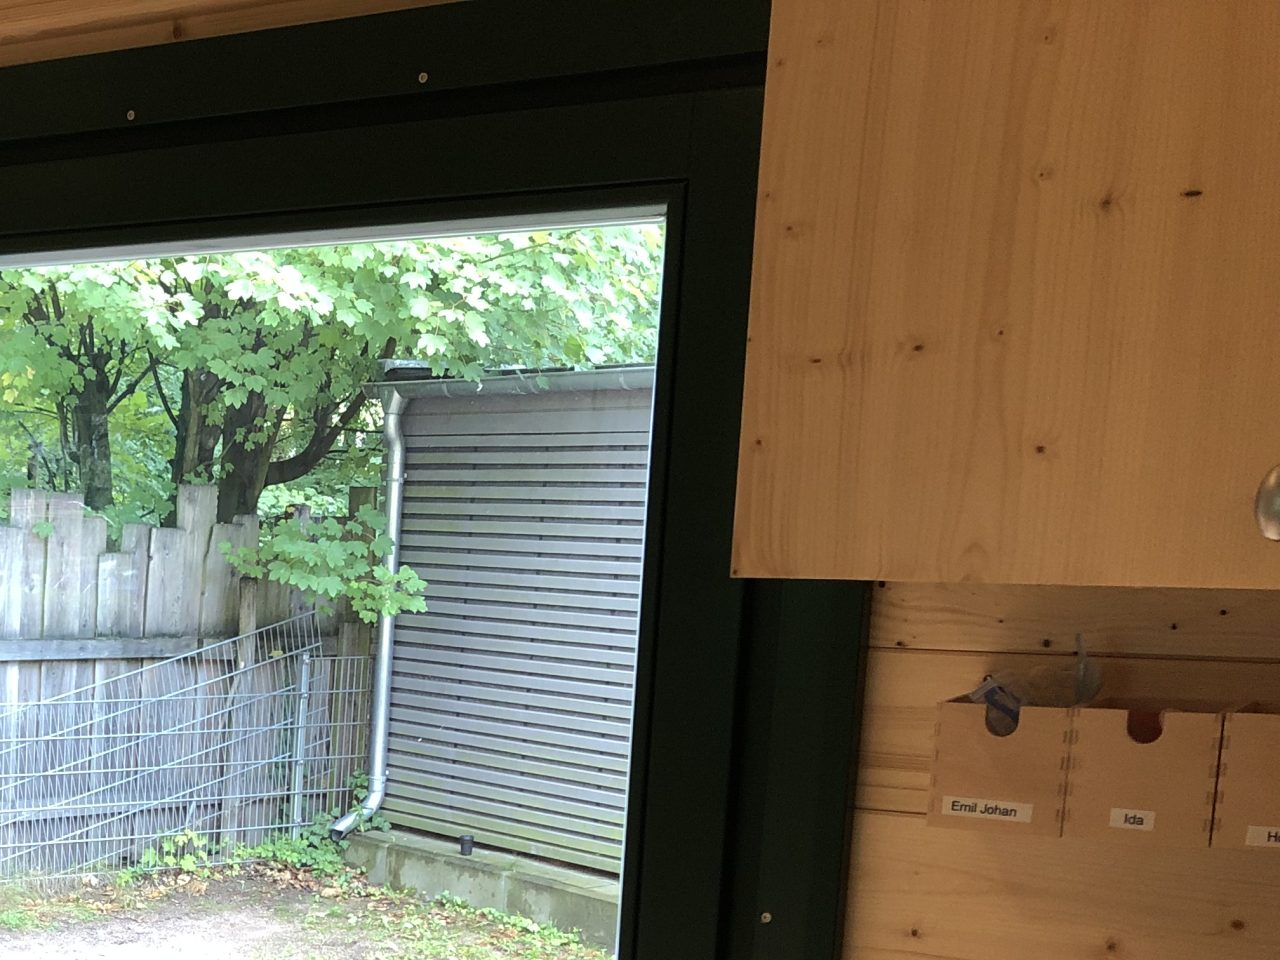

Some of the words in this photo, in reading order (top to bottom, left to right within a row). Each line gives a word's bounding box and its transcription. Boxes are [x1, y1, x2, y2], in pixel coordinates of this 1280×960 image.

[951, 800, 977, 813] Emil
[980, 804, 1017, 817] Johan
[1123, 813, 1144, 826] Ida
